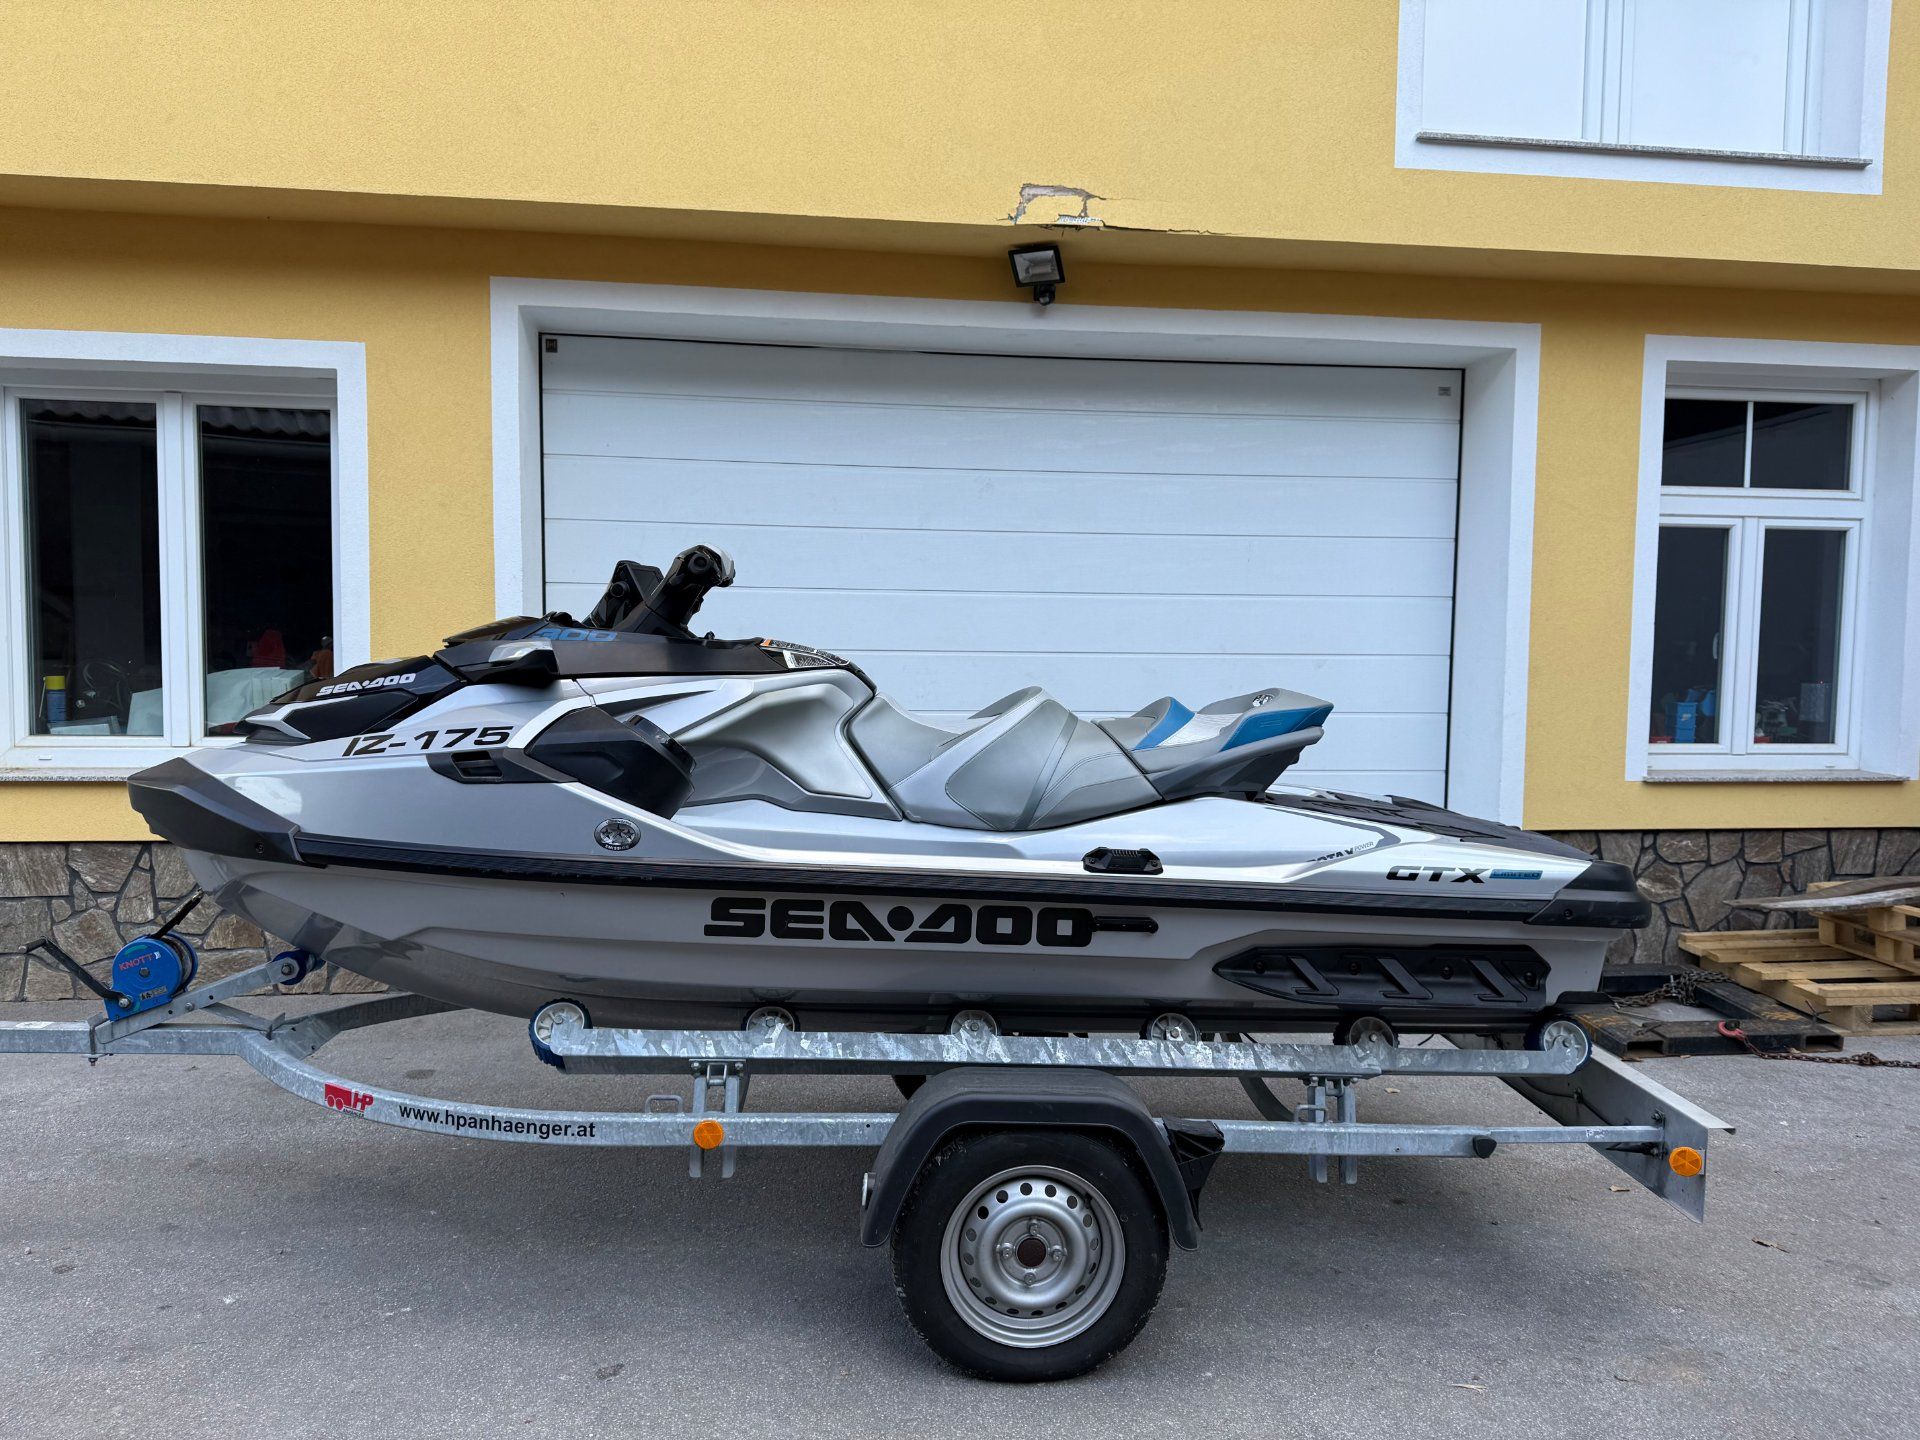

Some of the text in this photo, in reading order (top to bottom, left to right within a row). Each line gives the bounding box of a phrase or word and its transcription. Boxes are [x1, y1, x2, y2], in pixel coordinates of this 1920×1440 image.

[342, 726, 514, 757] IZ-175
[1354, 841, 1374, 852] POWER
[1386, 865, 1490, 884] GTX
[119, 953, 153, 971] KNOTT
[353, 1091, 374, 1111] HP
[398, 1104, 597, 1140] www.hpanhaenger.at
